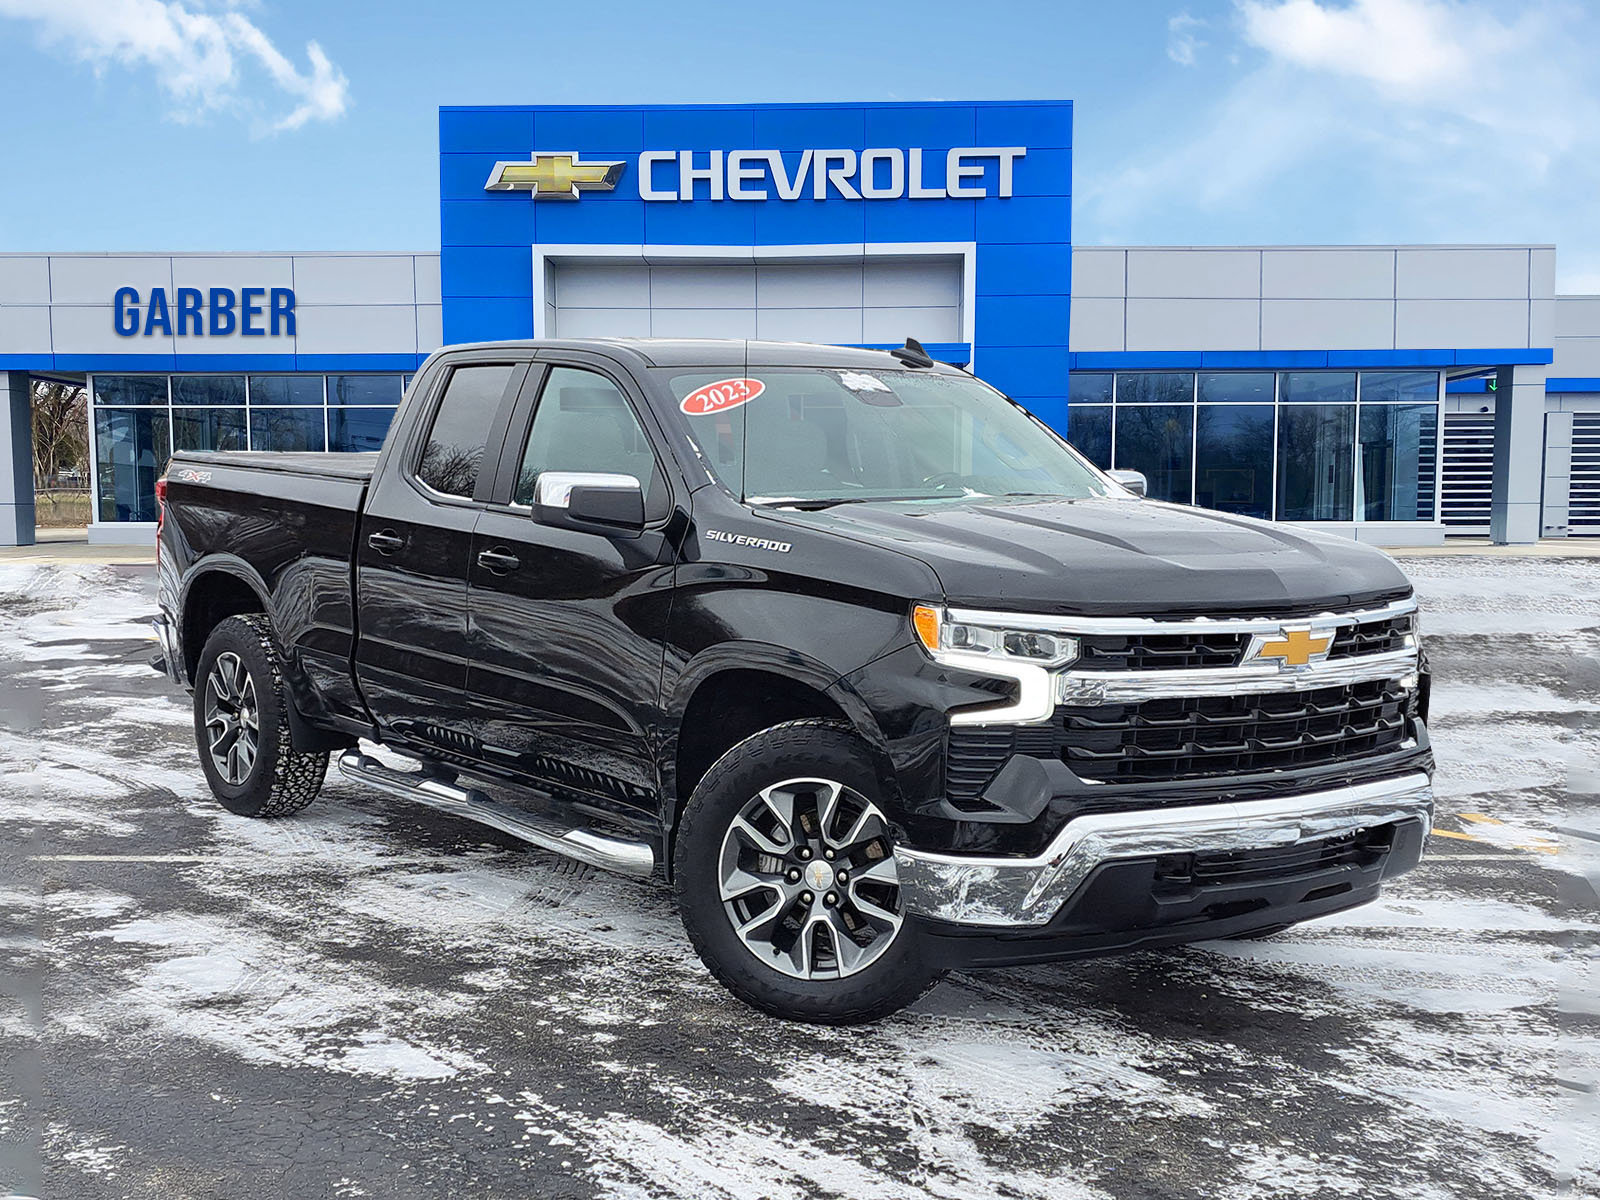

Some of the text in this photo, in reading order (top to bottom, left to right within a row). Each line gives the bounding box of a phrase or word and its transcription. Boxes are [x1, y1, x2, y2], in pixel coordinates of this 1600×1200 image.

[638, 146, 1026, 203] CHEVROLET
[114, 286, 296, 336] GARBER
[695, 380, 751, 412] 2023
[705, 530, 792, 553] SILVERADO
